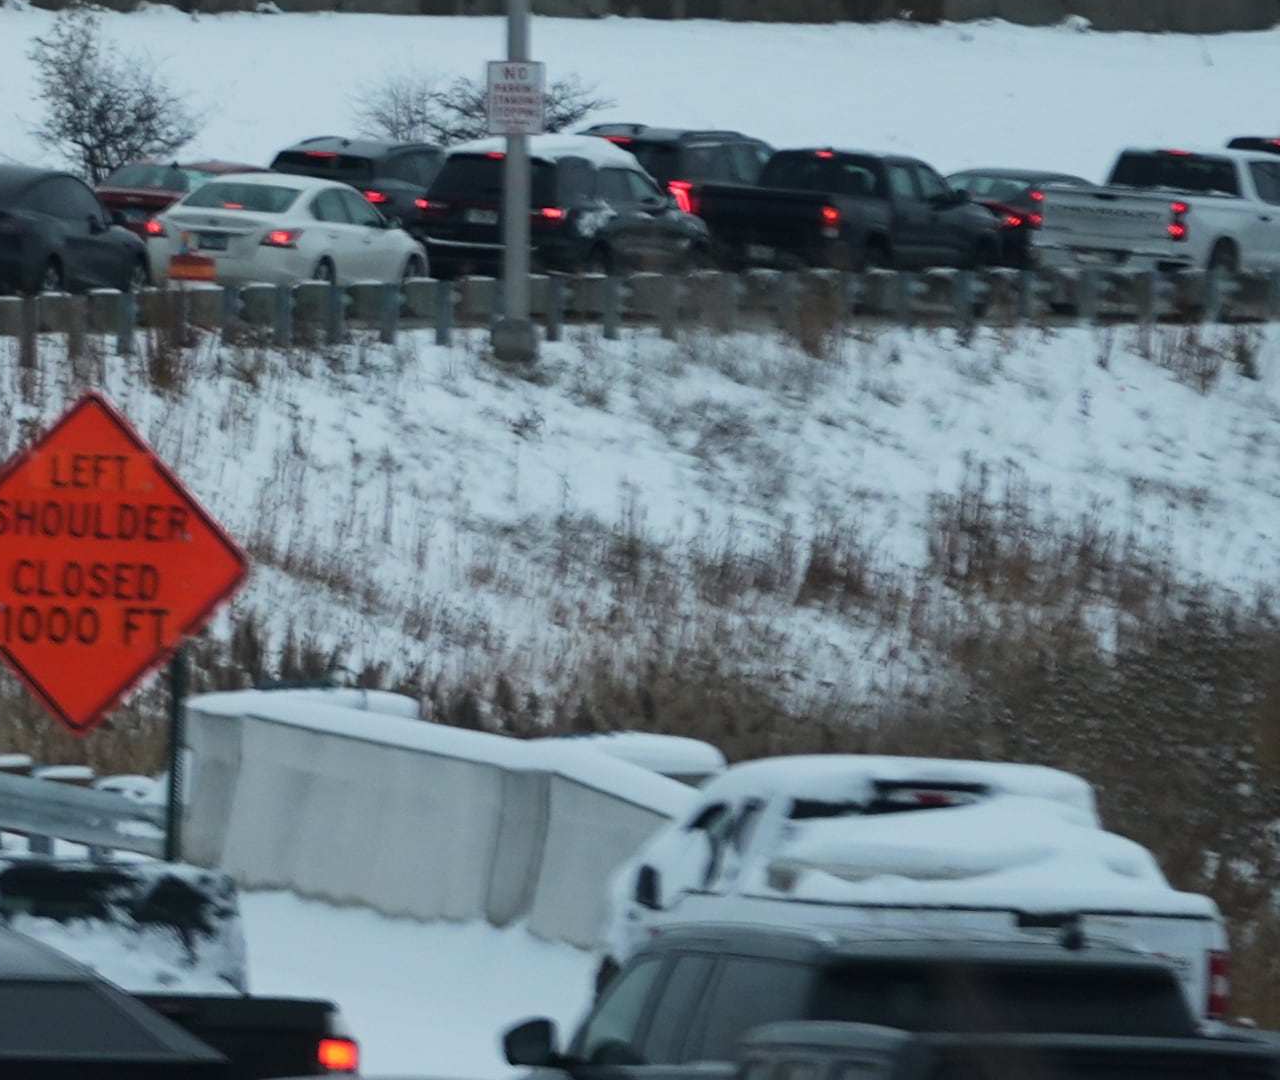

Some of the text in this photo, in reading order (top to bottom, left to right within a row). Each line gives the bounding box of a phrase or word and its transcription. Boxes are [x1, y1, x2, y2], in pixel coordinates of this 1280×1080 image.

[503, 66, 528, 81] NO
[50, 454, 130, 490] LEFT
[11, 558, 161, 602] CLOSED
[0, 605, 172, 649] 1000 FT
